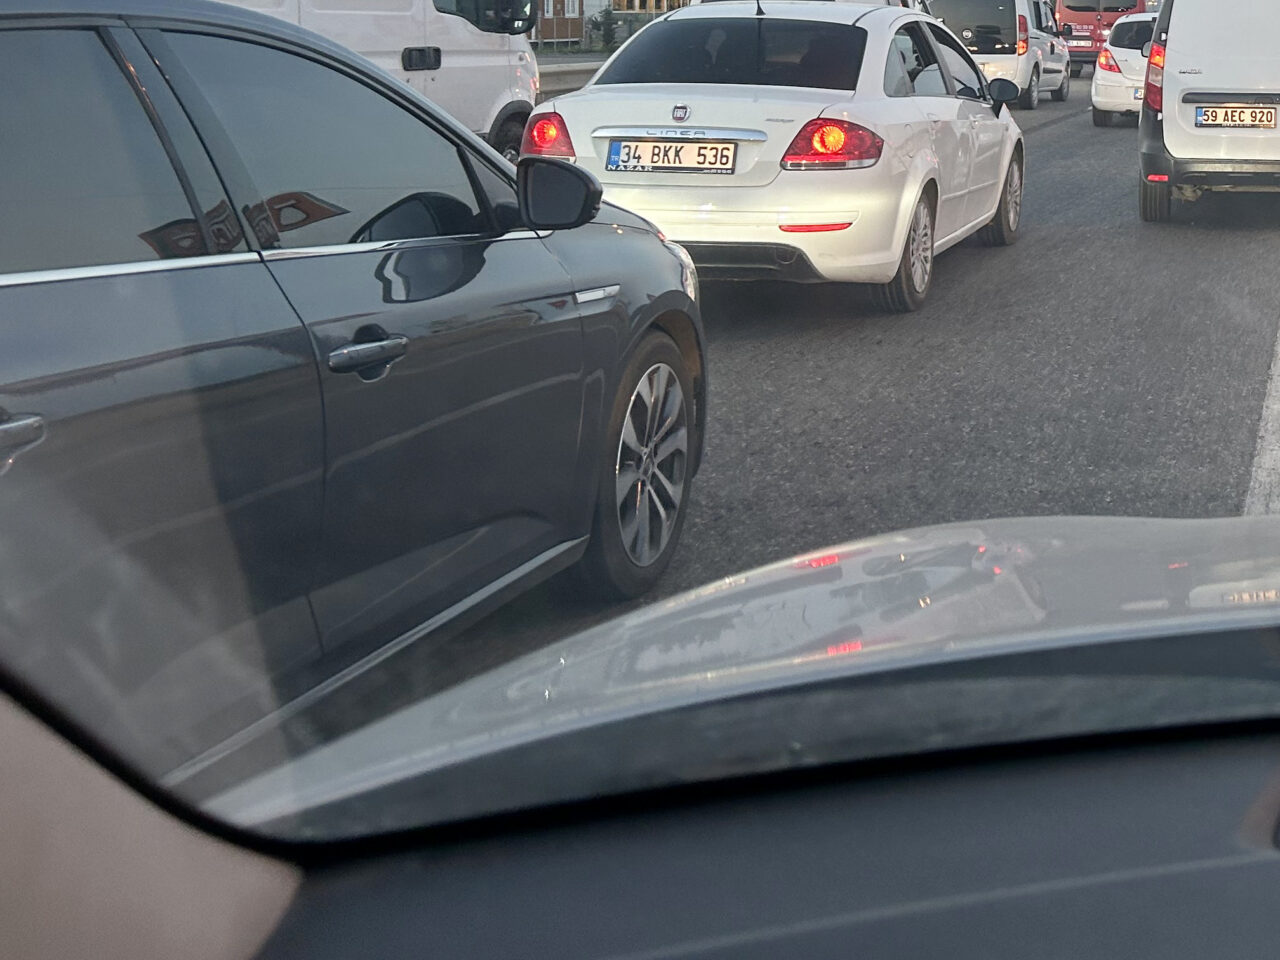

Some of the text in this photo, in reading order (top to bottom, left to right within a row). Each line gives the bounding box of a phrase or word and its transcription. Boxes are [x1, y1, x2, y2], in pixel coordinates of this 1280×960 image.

[1202, 109, 1273, 123] 59 AEC 920
[621, 145, 730, 165] 34 BKK 536
